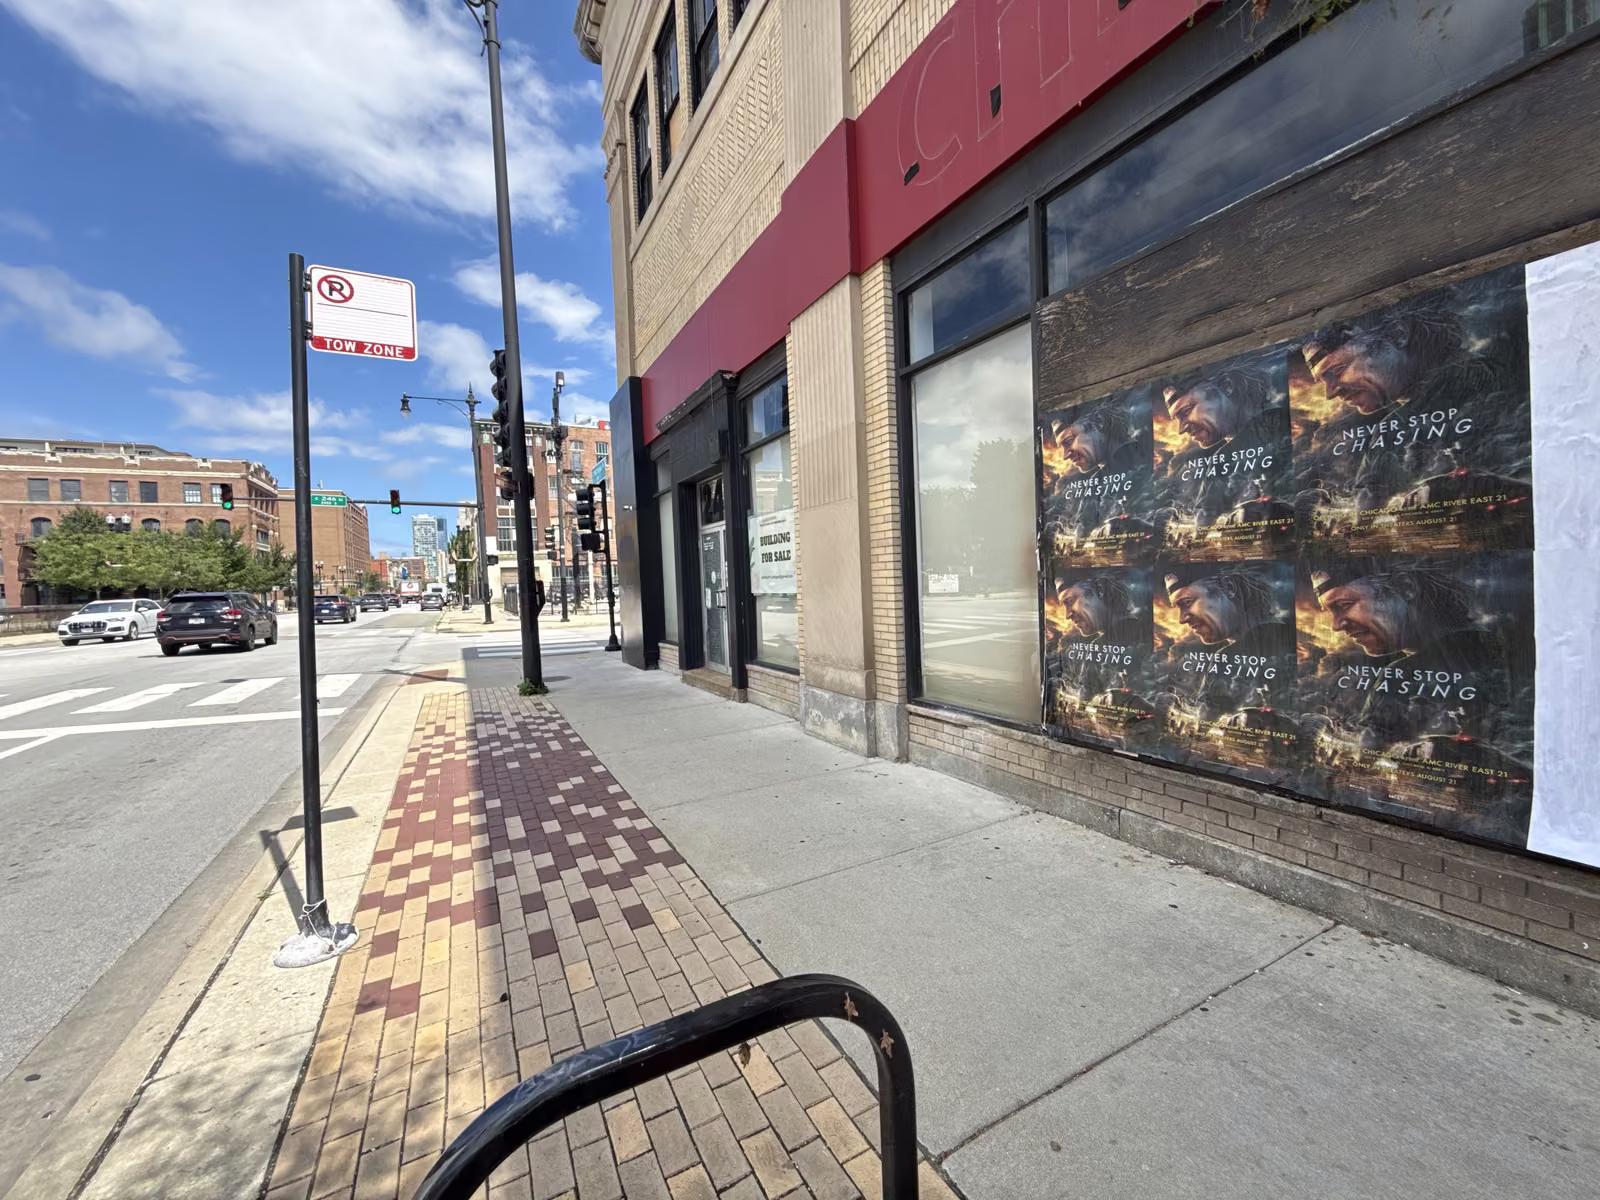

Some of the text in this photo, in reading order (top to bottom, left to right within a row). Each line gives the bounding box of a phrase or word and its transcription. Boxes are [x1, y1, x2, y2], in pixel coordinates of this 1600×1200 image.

[324, 338, 404, 358] TOW ZONE
[1343, 408, 1458, 440] NEVER STOP
[1332, 418, 1472, 456] CHASING
[1188, 446, 1264, 469] NEVER STOP
[1181, 456, 1273, 481] CHASING
[1065, 480, 1132, 500] CHASING
[1070, 472, 1126, 490] NEVER STOP
[1360, 507, 1398, 516] CHICAGO
[1421, 501, 1441, 509] AMC
[1443, 498, 1468, 507] RIVER
[1470, 495, 1494, 505] EAST
[1496, 494, 1507, 502] 21
[1416, 517, 1447, 525] AUGUST
[760, 531, 791, 547] BUILDING
[761, 549, 792, 564] FOR SALE
[1068, 650, 1132, 665] CHASING
[1072, 642, 1126, 654] NEVER STOP
[1189, 652, 1266, 666] NEVER STOP
[1182, 660, 1276, 679] CHASING
[1347, 665, 1462, 684] NEVER STOP
[1337, 676, 1477, 701] CHASING
[1254, 728, 1271, 737] RIVER
[1272, 731, 1288, 740] EAST
[1352, 761, 1371, 769] ONLY
[1417, 773, 1447, 783] AUGUST
[1363, 748, 1399, 759] CHICAGO
[1422, 758, 1443, 767] AMC
[1445, 761, 1469, 771] RIVER
[1472, 766, 1495, 776] EAST
[1497, 770, 1508, 778] 21
